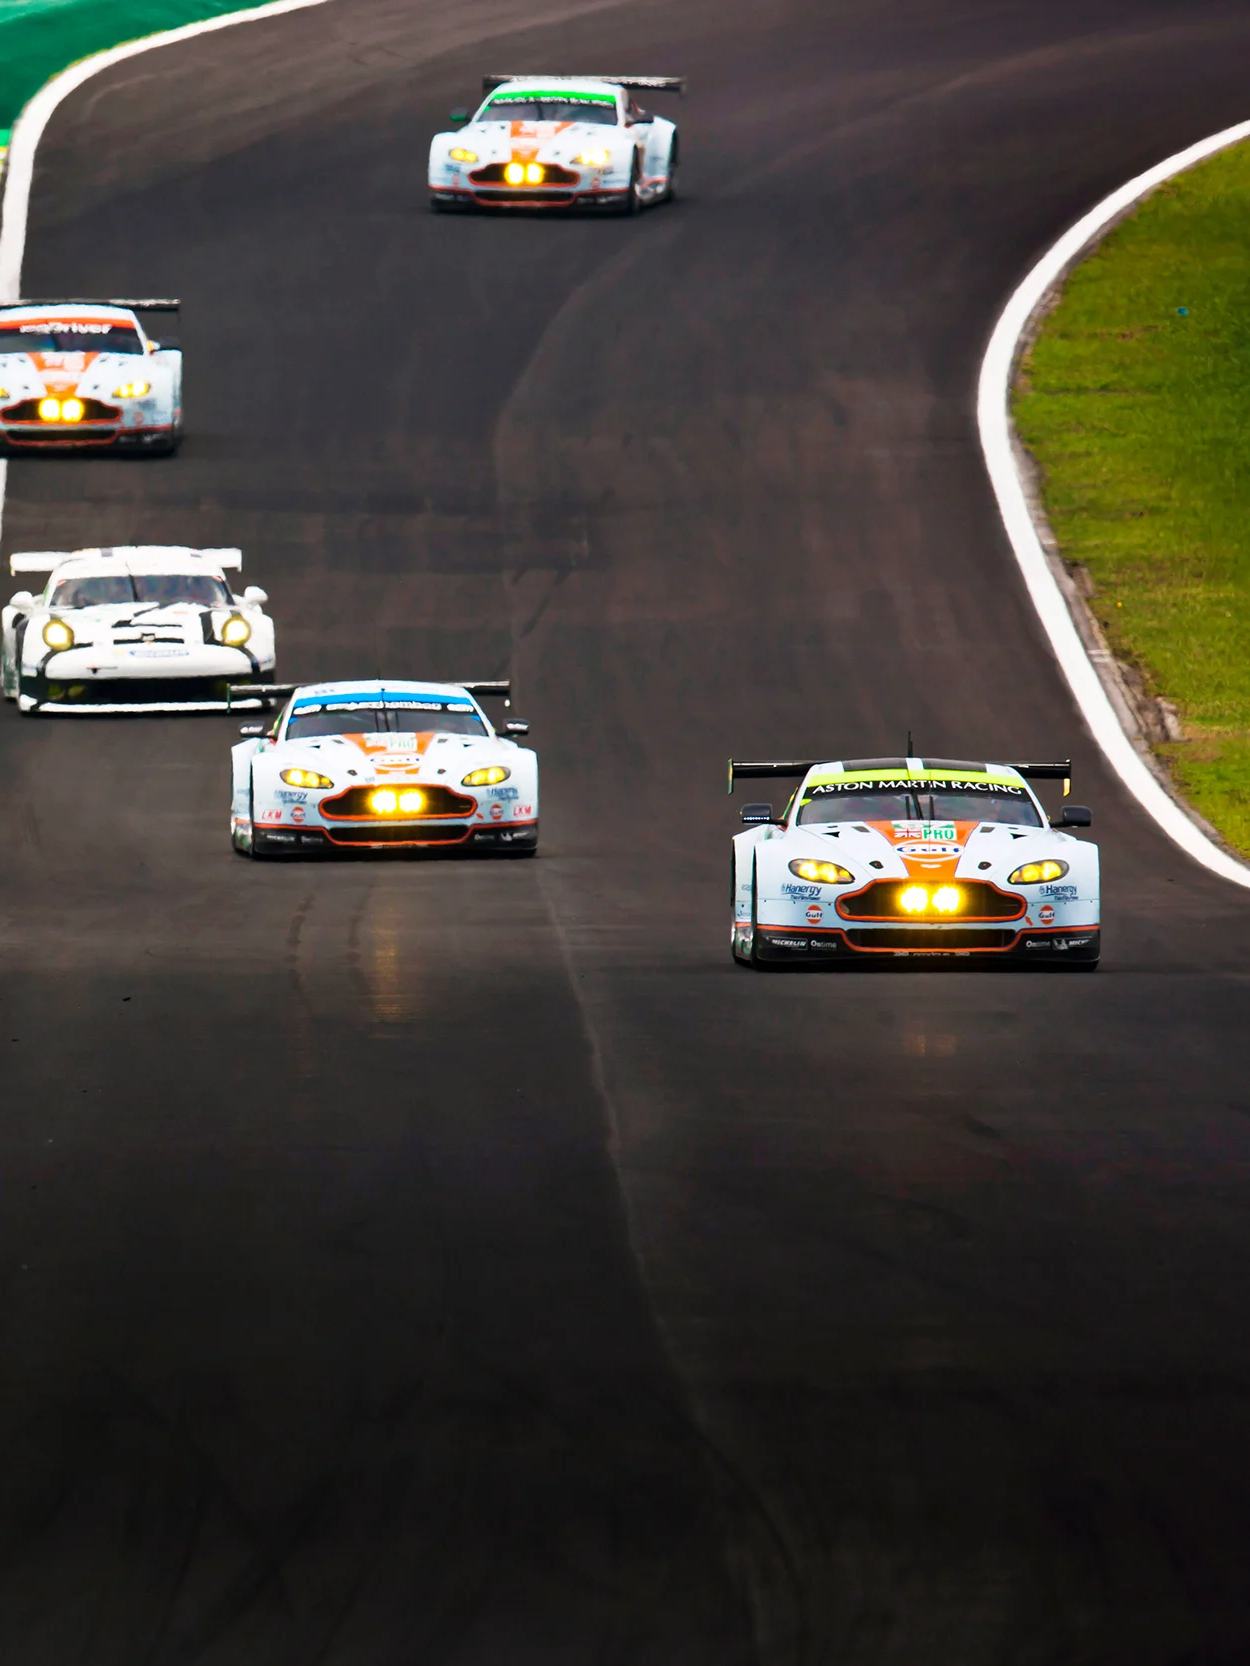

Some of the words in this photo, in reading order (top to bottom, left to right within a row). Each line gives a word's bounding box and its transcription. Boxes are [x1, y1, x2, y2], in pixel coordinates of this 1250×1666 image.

[812, 780, 874, 794] ASTON
[878, 779, 947, 789] MARTIN
[952, 780, 1022, 795] RACING
[923, 829, 955, 840] PRO
[785, 884, 822, 896] Hanergy
[1046, 885, 1077, 896] Hanergy
[771, 939, 807, 947] MICHELIN
